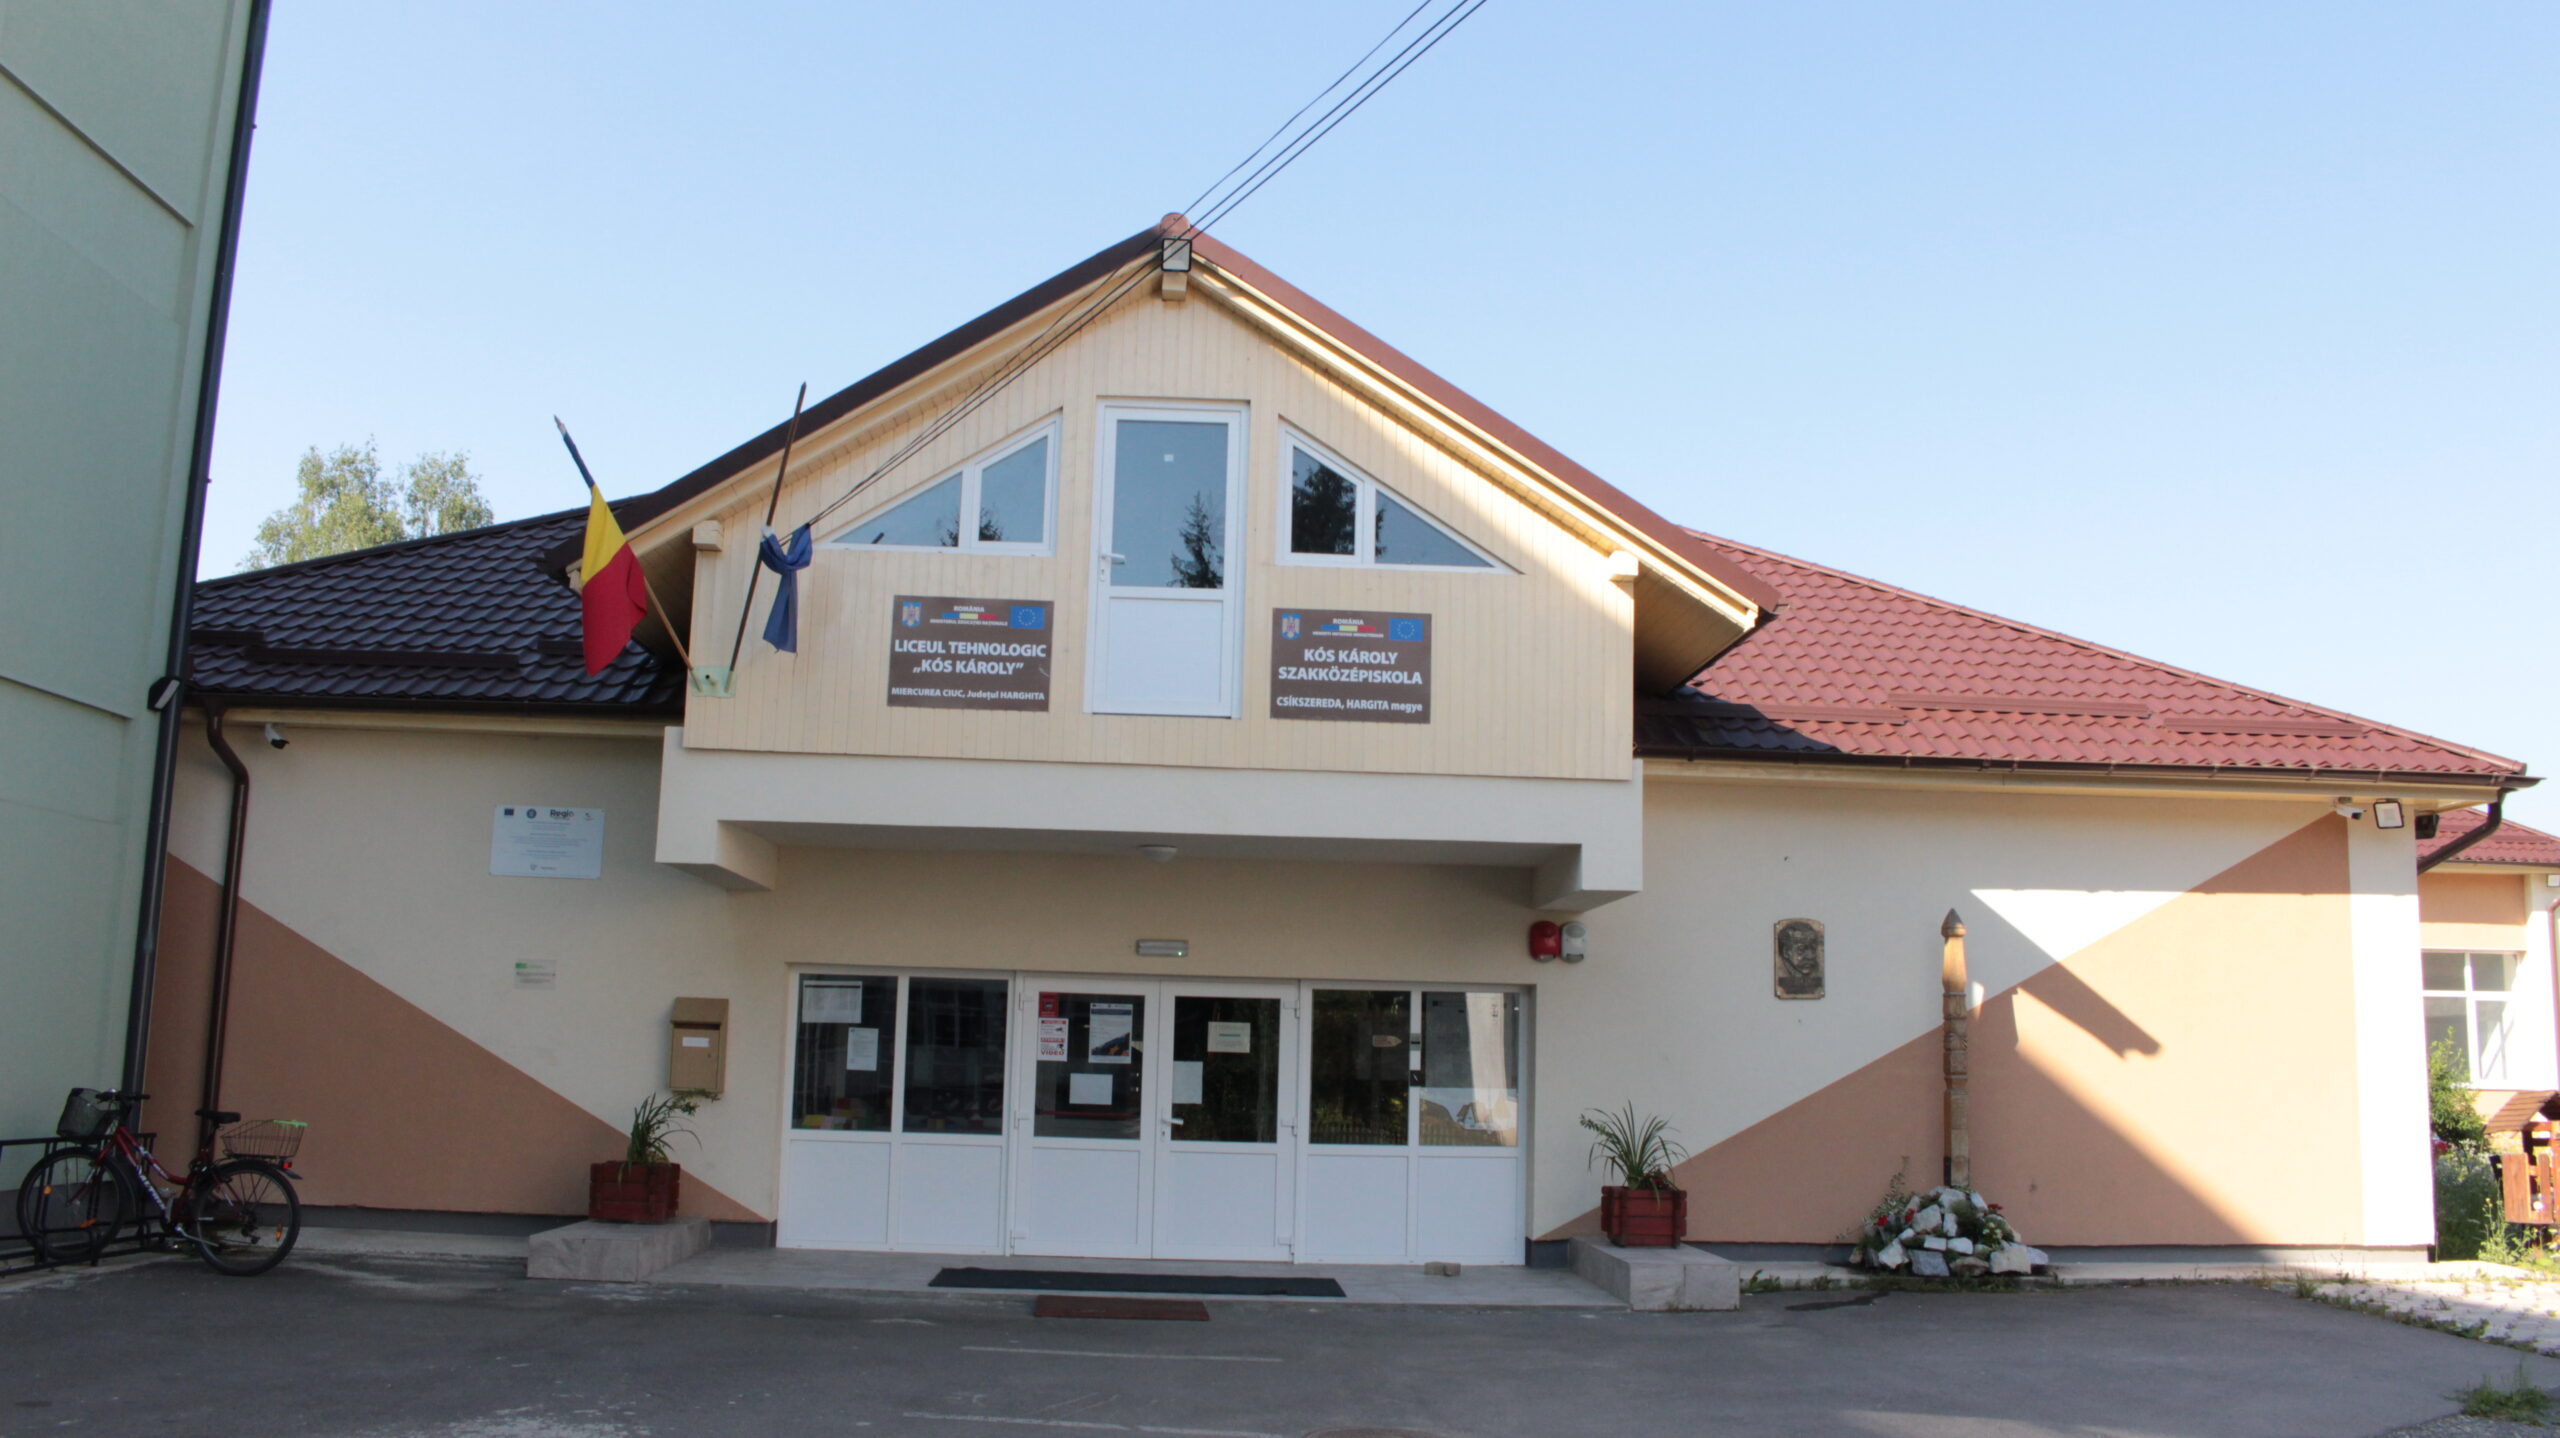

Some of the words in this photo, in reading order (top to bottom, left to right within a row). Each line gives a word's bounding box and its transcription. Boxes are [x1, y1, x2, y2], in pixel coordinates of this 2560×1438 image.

[953, 605, 985, 613] ROMÂNIA
[1332, 617, 1365, 626] ROMÂNIA
[894, 639, 946, 654] LICEUL
[948, 641, 1047, 658] TEHNOLOGIC
[1304, 646, 1335, 663] KÓS
[1338, 647, 1398, 665] KÁROLY
[1278, 665, 1423, 685] SZAKKÖZÉPISKOLA
[891, 687, 942, 697] MIERCUREA
[943, 689, 965, 698] CIUC,
[1000, 691, 1045, 701] HARGHITA
[1276, 695, 1344, 710] CSÍKSZEREDA,
[1346, 699, 1389, 711] HARGITA
[1391, 702, 1423, 713] megye
[550, 808, 575, 819] Regio
